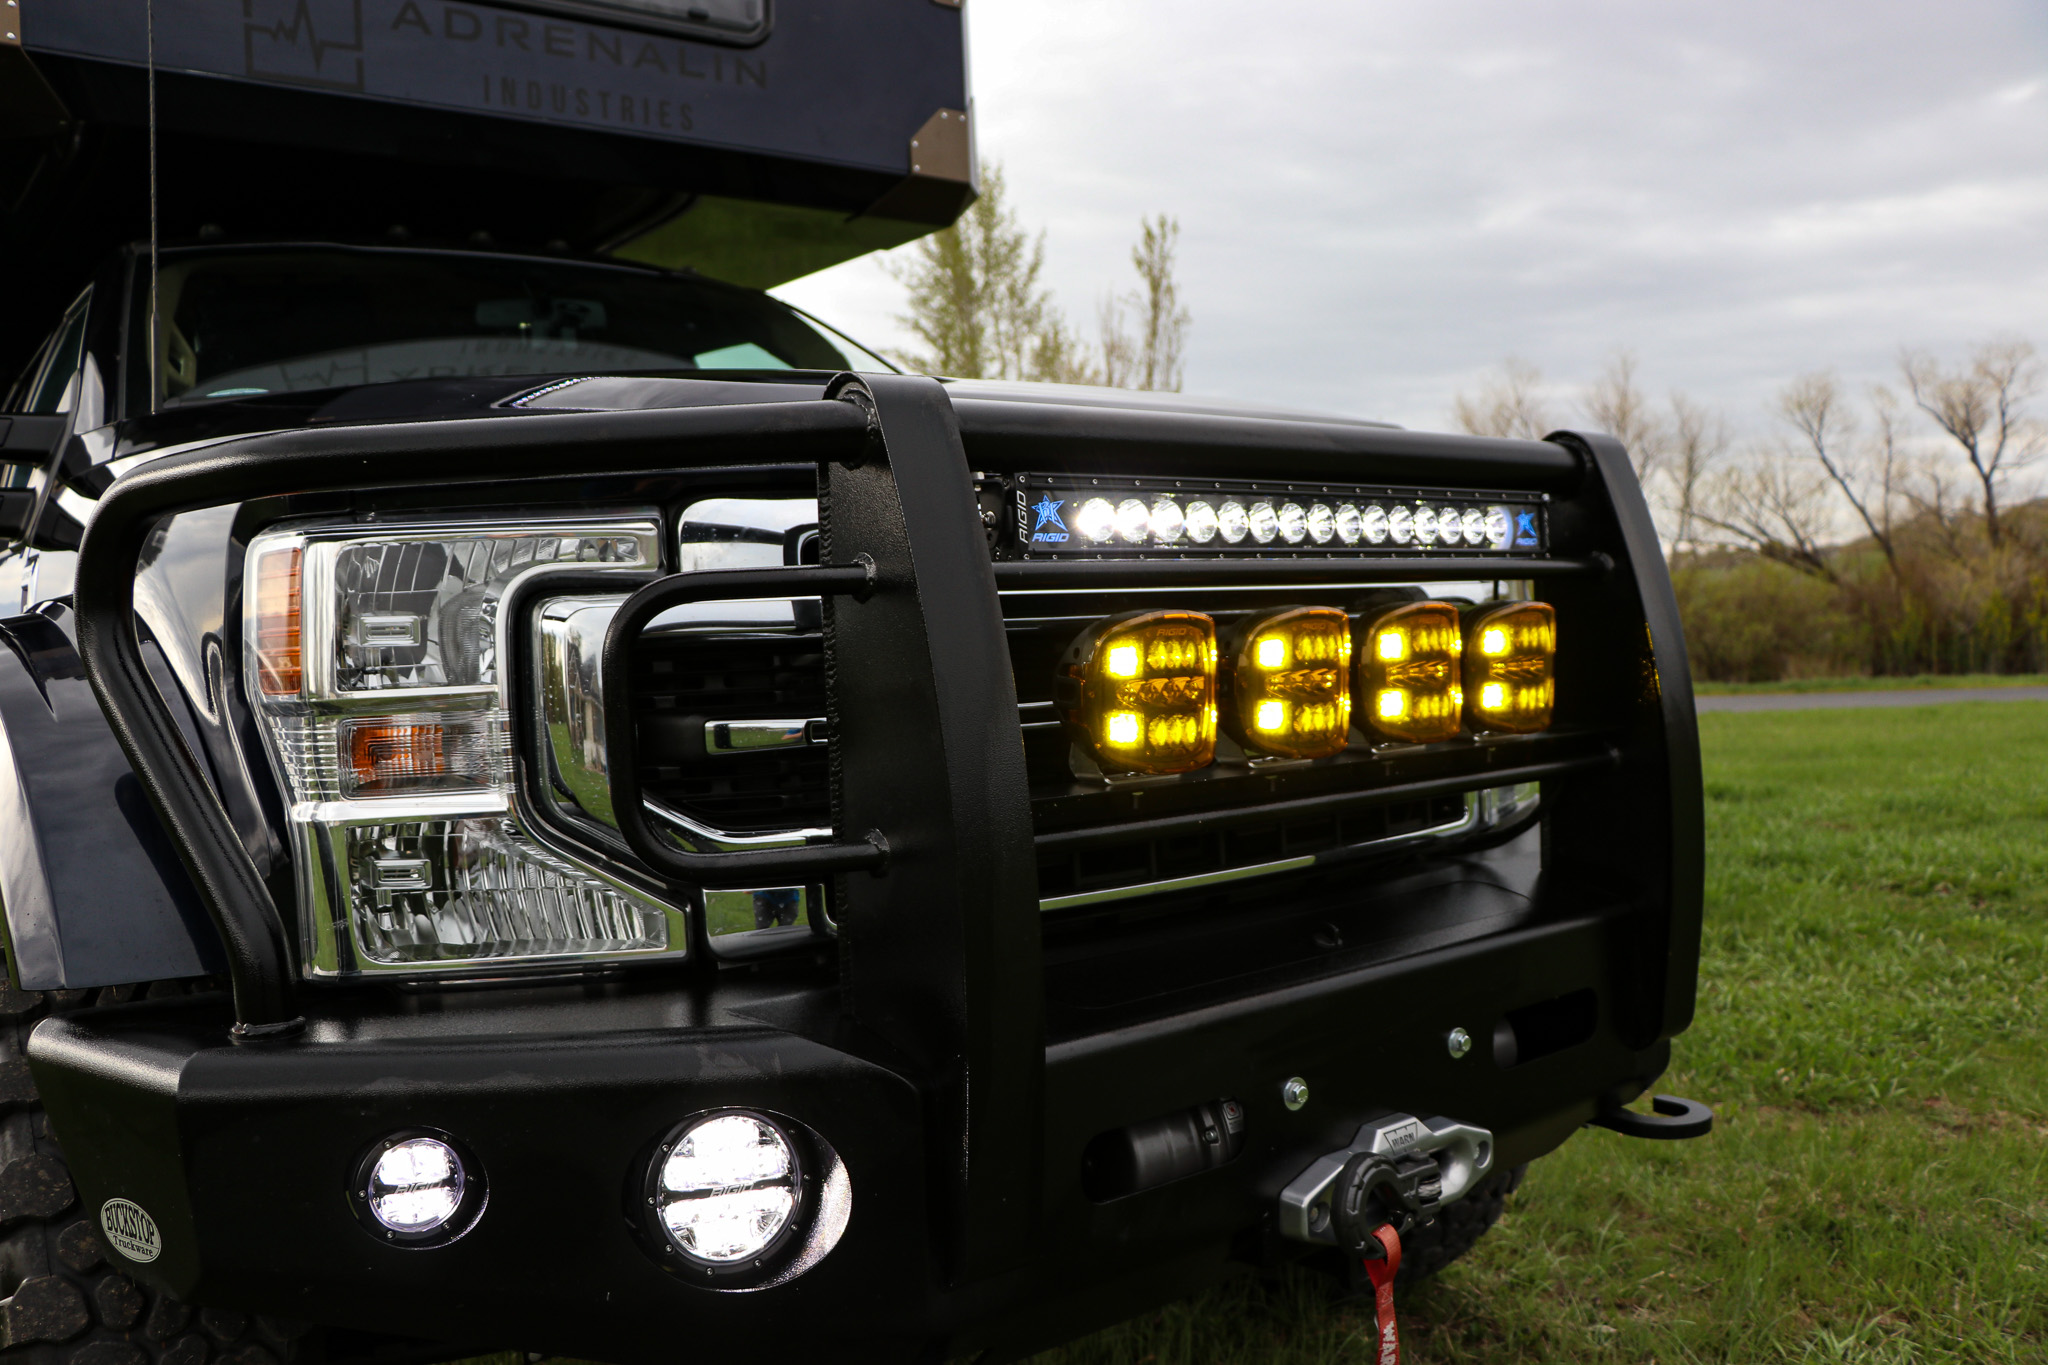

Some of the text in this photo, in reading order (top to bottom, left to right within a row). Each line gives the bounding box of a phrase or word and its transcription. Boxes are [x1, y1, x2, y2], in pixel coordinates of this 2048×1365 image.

[390, 0, 767, 90] ADRENALIN
[482, 74, 695, 131] INDUSTRIES
[1016, 490, 1029, 544] RIGID
[1032, 532, 1070, 542] RIGID
[1156, 627, 1187, 637] RIGID
[1391, 1131, 1416, 1148] WARN
[394, 1181, 442, 1194] RIGID
[710, 1182, 754, 1197] RIGID
[105, 1203, 155, 1246] BUCKSTOP
[113, 1234, 154, 1258] Truckware
